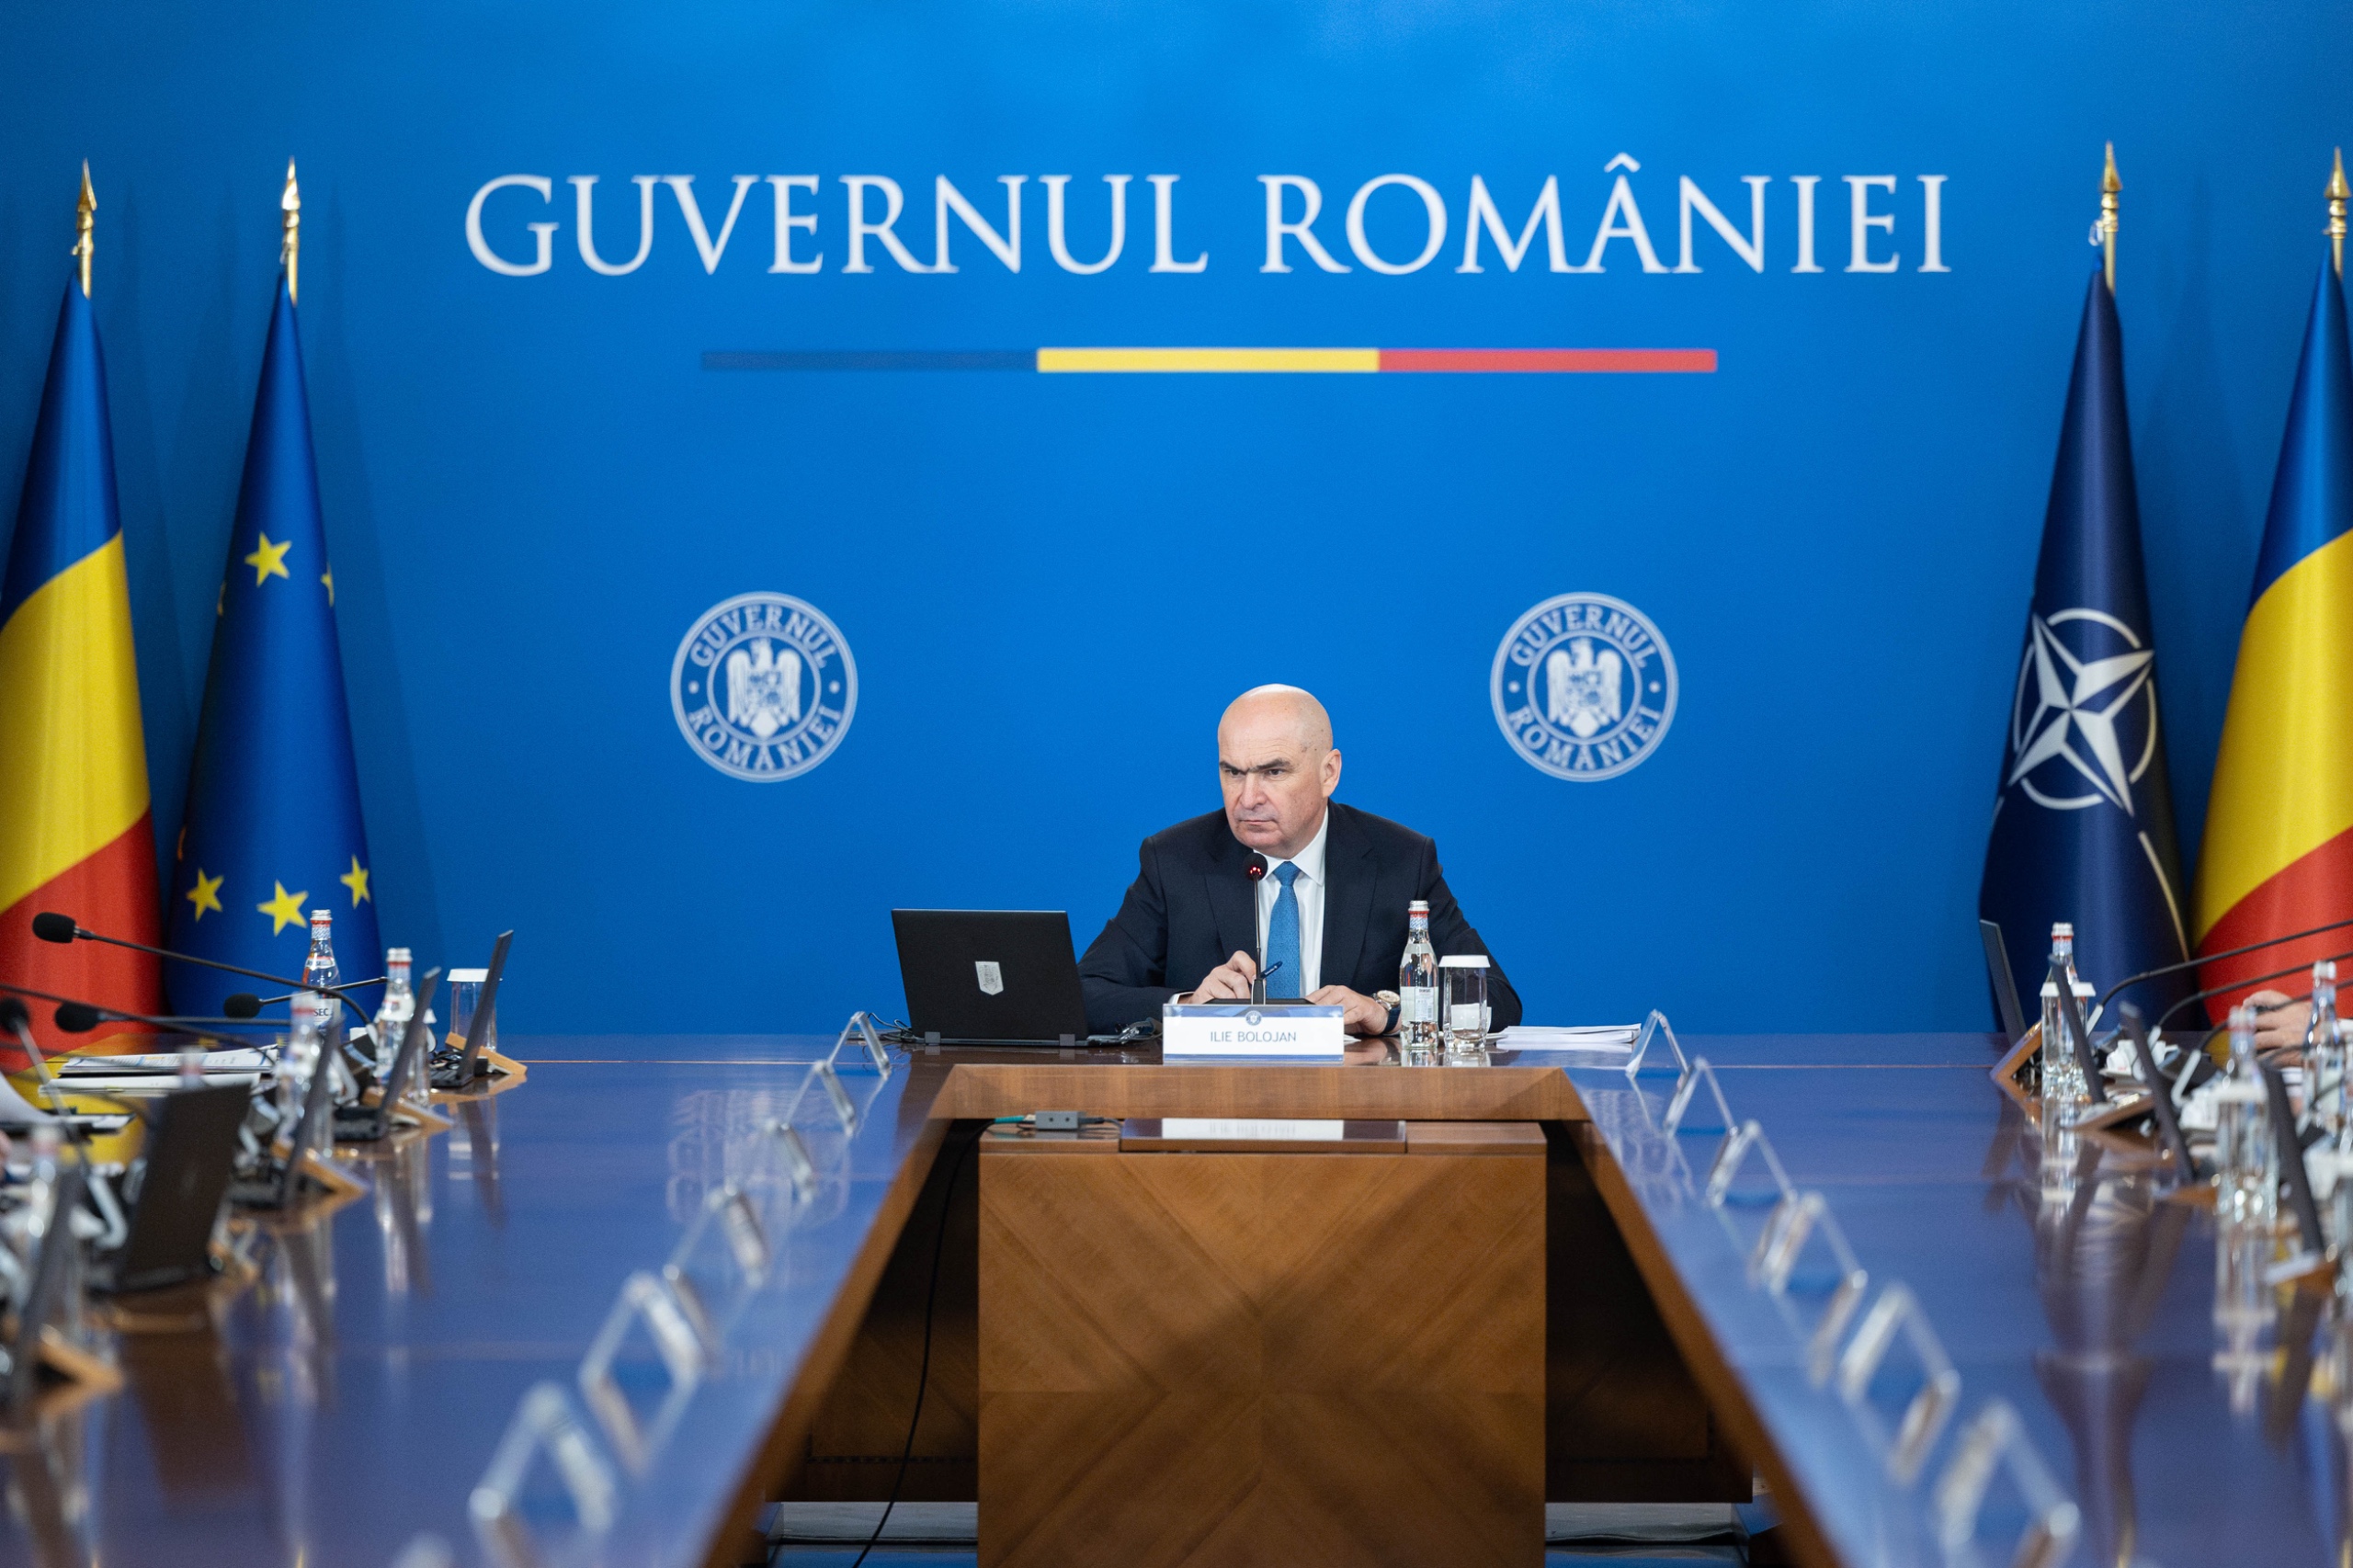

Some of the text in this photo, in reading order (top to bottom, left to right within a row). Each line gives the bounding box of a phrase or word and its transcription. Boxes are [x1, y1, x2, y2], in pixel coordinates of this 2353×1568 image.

[463, 153, 1951, 278] GUVERNUL ROMÂNIEI
[690, 604, 837, 669] GUVERNUL
[1510, 604, 1657, 669] GUVERNUL
[1210, 1030, 1297, 1042] ILIE BOLOJAN
